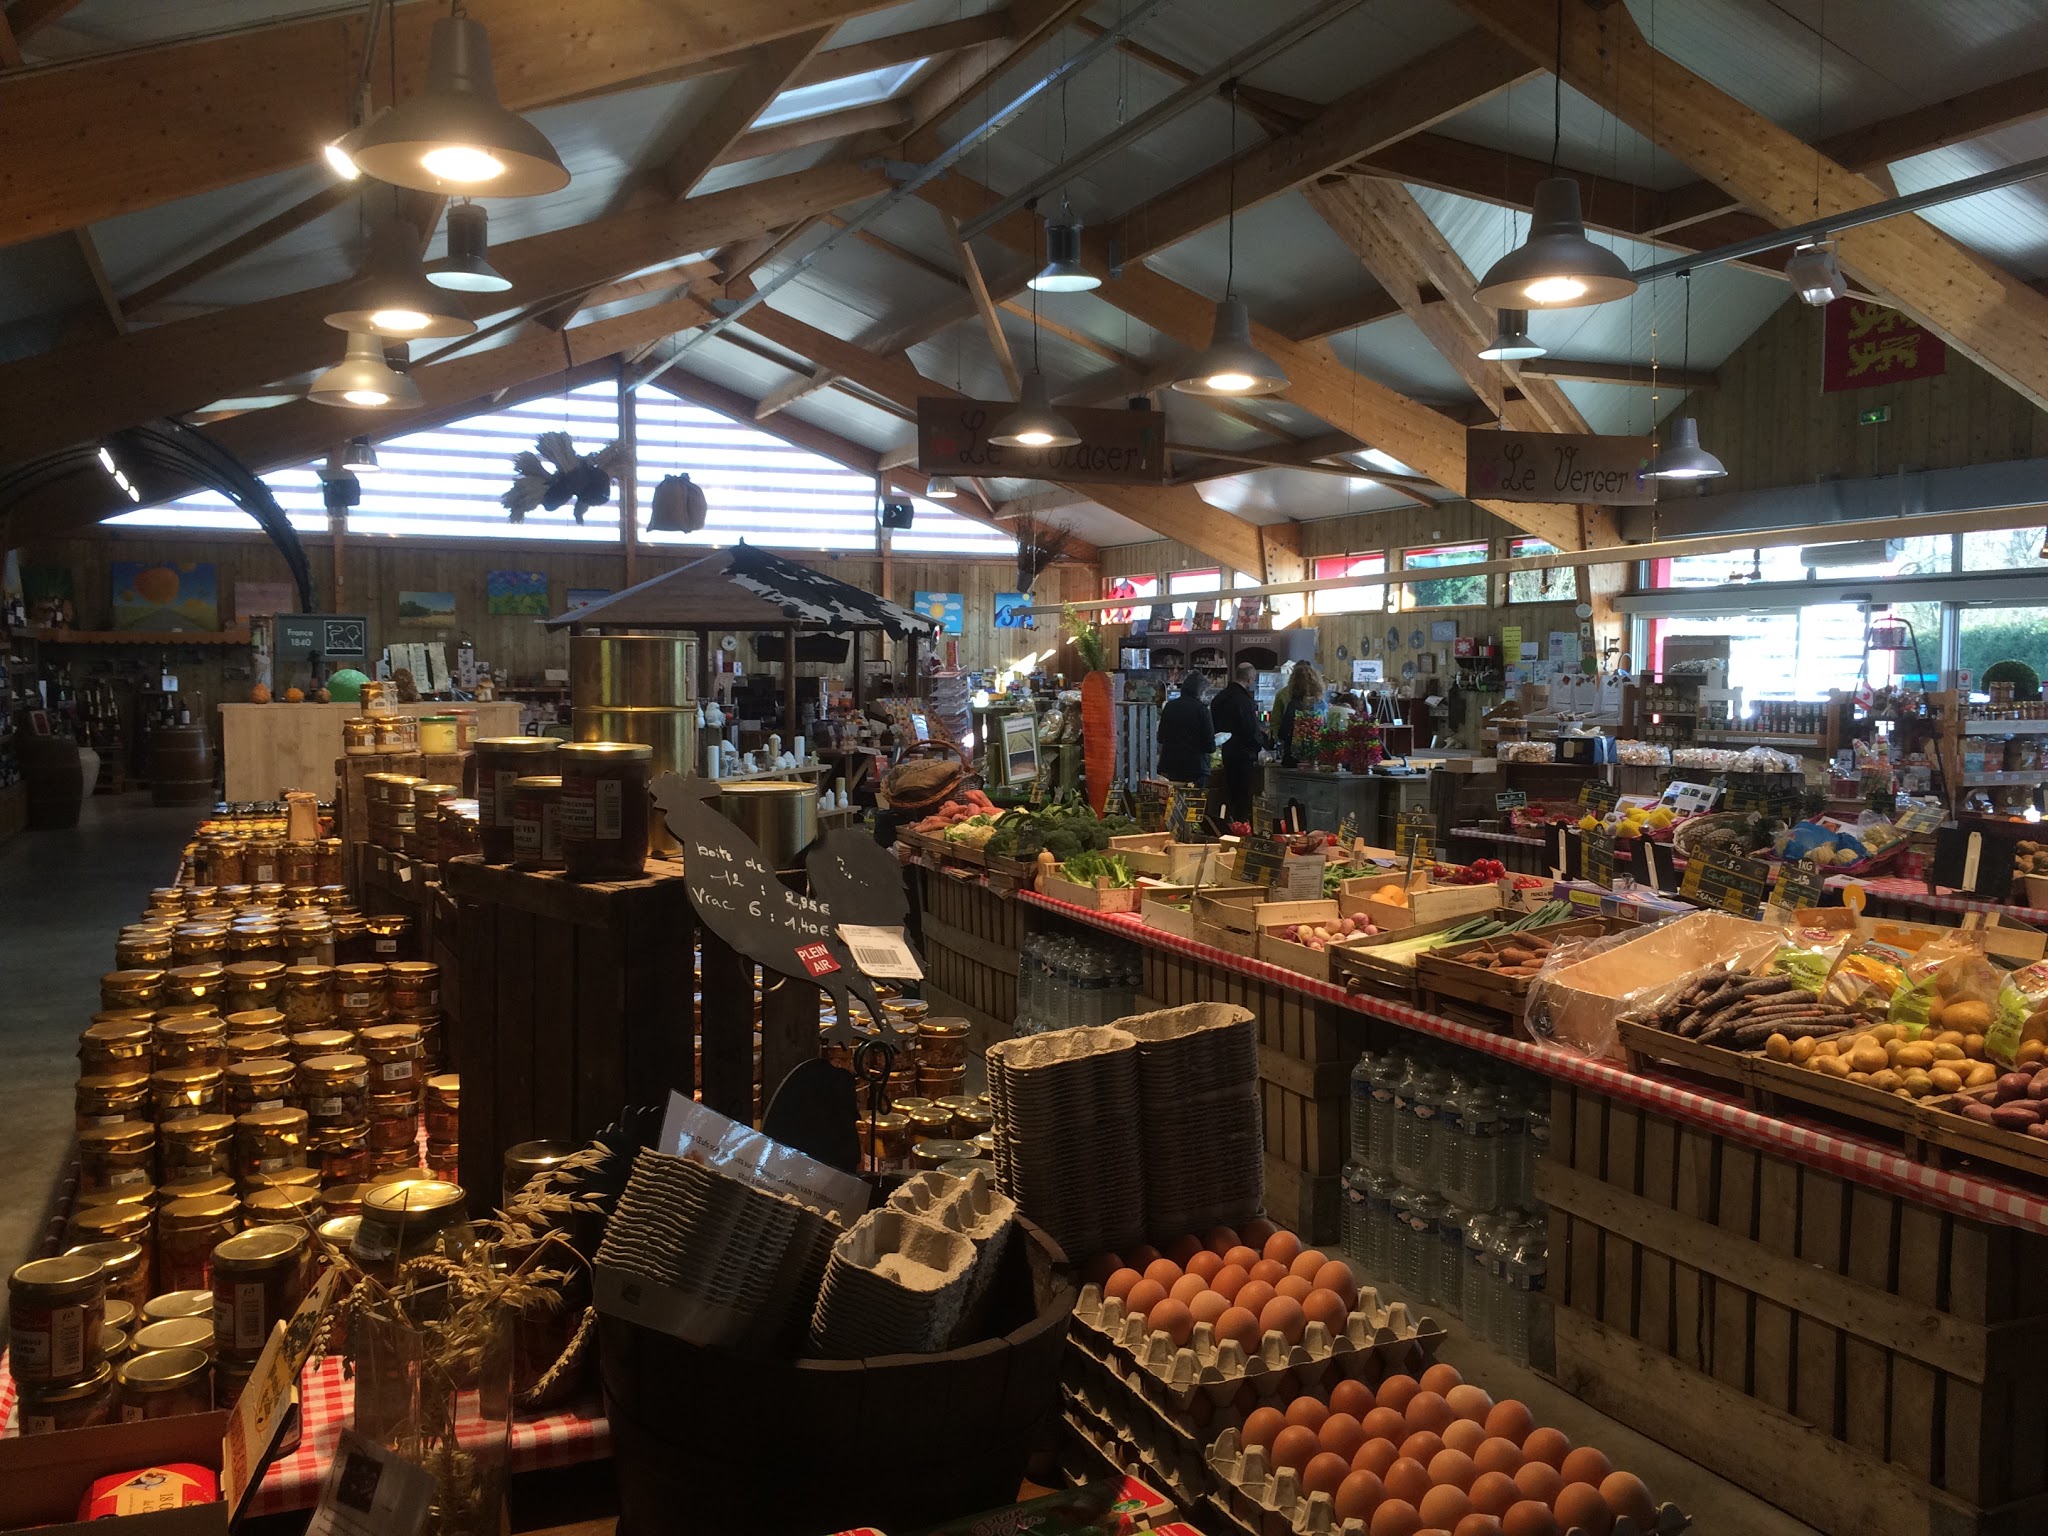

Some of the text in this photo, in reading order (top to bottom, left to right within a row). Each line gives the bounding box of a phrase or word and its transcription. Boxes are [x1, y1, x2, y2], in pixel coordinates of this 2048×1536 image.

[959, 410, 1001, 465] Le
[1502, 443, 1536, 492] Le
[287, 628, 313, 637] France
[291, 638, 312, 646] 1840
[745, 857, 766, 875] de
[1798, 859, 1813, 870] 1KG
[692, 886, 736, 911] Vrac
[749, 900, 762, 918] 6
[799, 943, 829, 962] PLEIN
[812, 959, 833, 974] AIR
[800, 1186, 813, 1197] VAN
